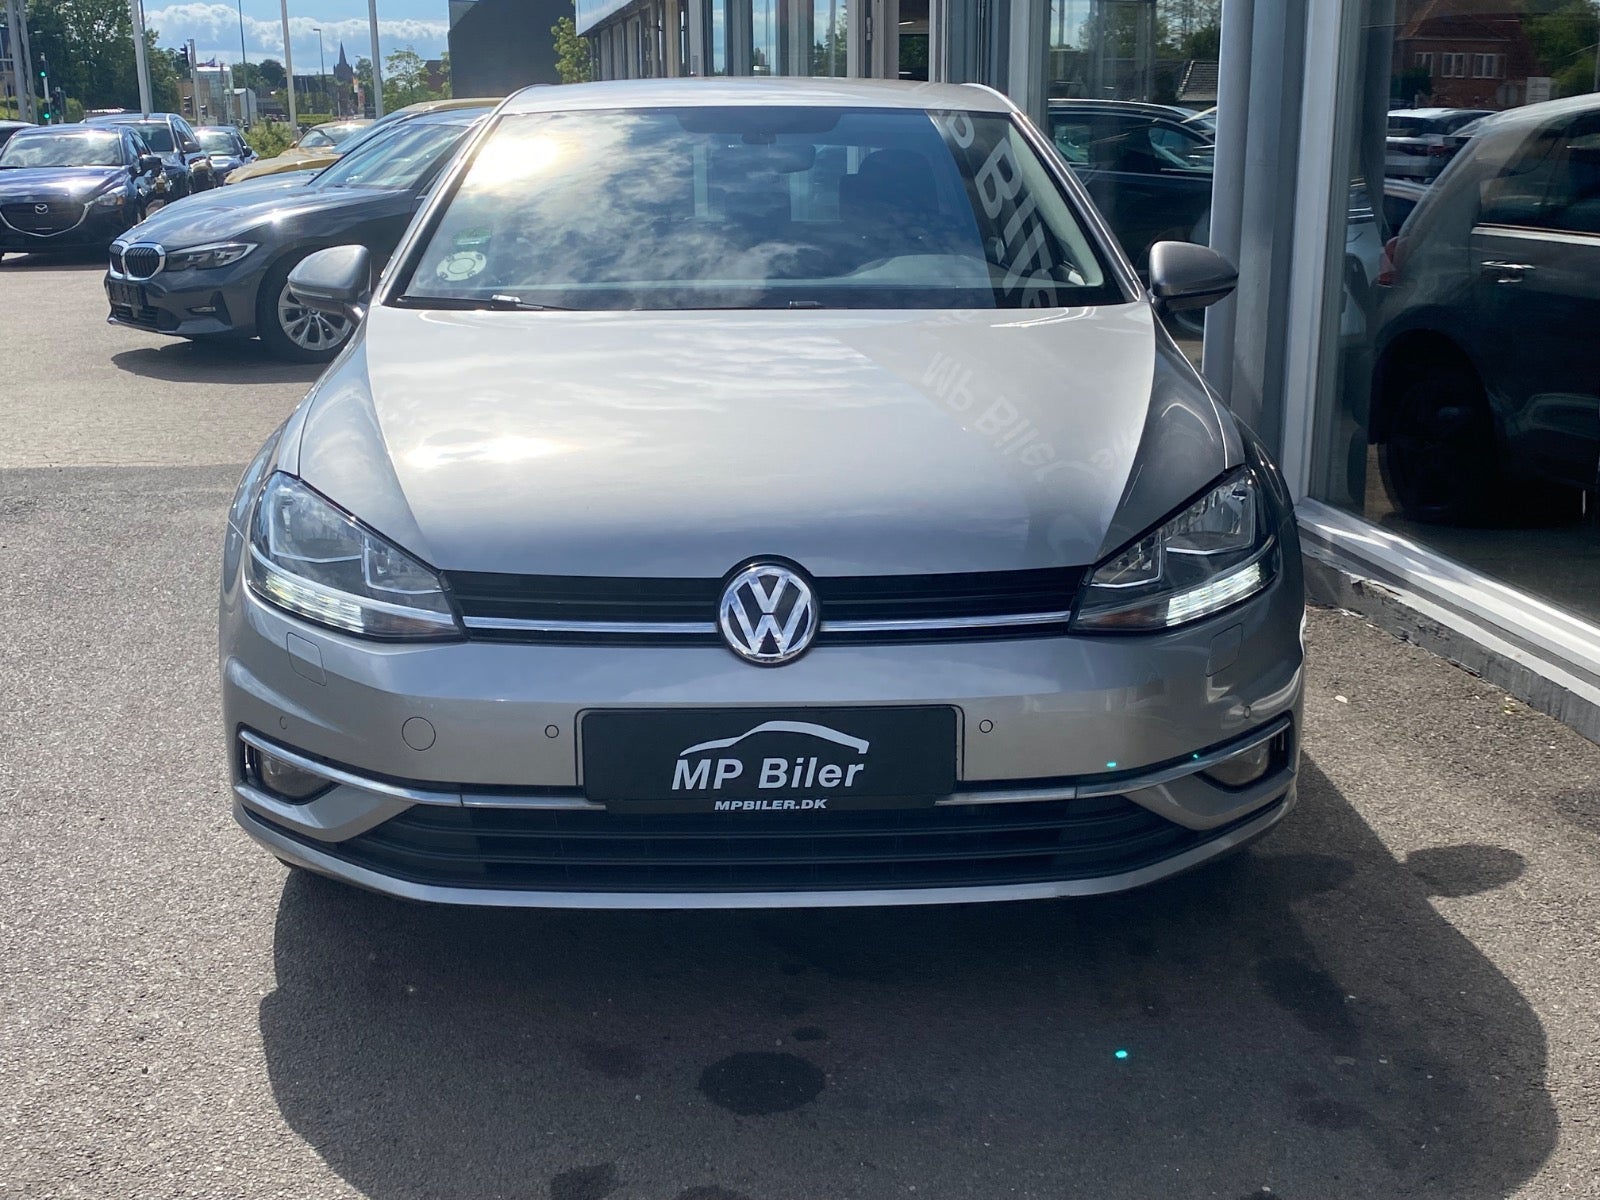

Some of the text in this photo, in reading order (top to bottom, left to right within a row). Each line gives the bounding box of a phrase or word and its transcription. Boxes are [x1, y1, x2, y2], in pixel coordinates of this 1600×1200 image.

[671, 757, 865, 790] MP Biler
[714, 799, 828, 811] MPBILER.DK
